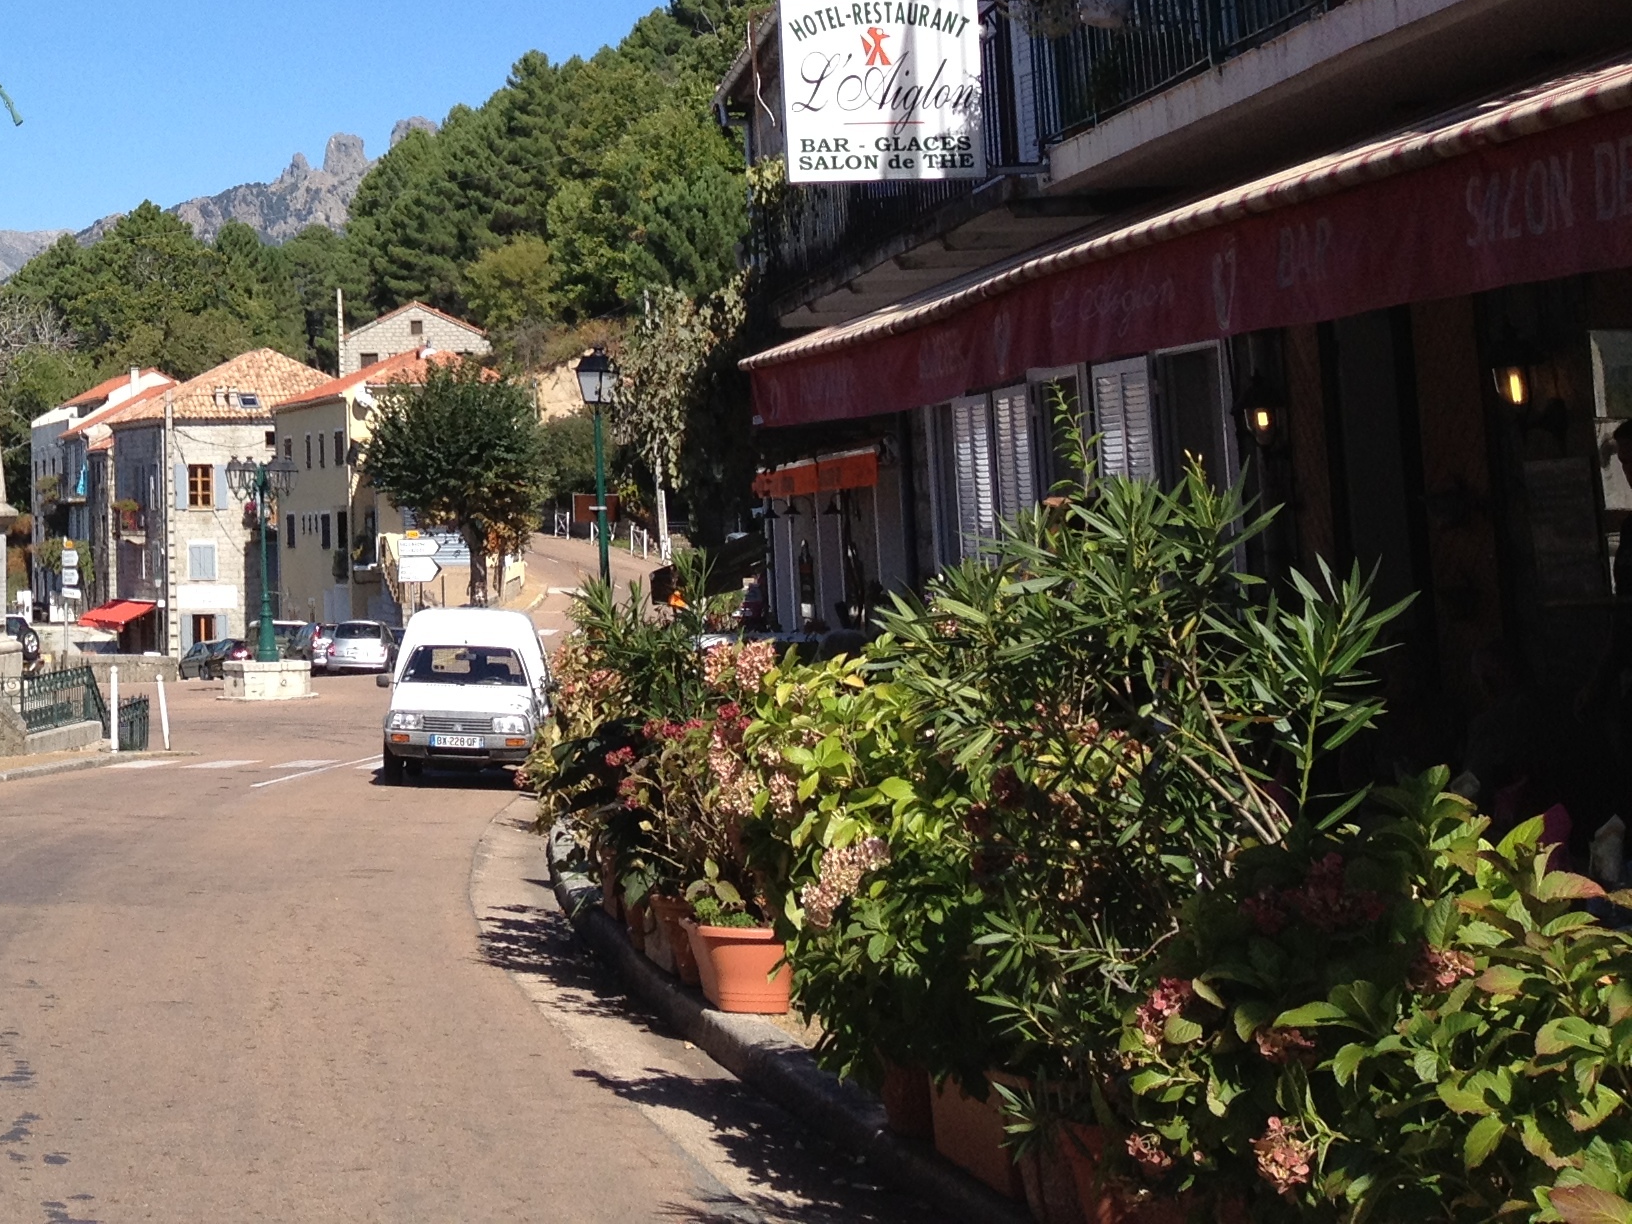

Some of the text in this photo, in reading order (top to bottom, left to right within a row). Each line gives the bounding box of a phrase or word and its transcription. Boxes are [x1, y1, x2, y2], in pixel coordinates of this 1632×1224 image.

[788, 1, 971, 42] HOTEL-RESTAURANT
[792, 51, 976, 135] L'Aiglon
[799, 153, 975, 170] SALON de THE
[800, 138, 850, 153] BAR
[874, 136, 972, 152] GLACES
[1277, 216, 1334, 288] BAR
[1466, 150, 1573, 247] SALON
